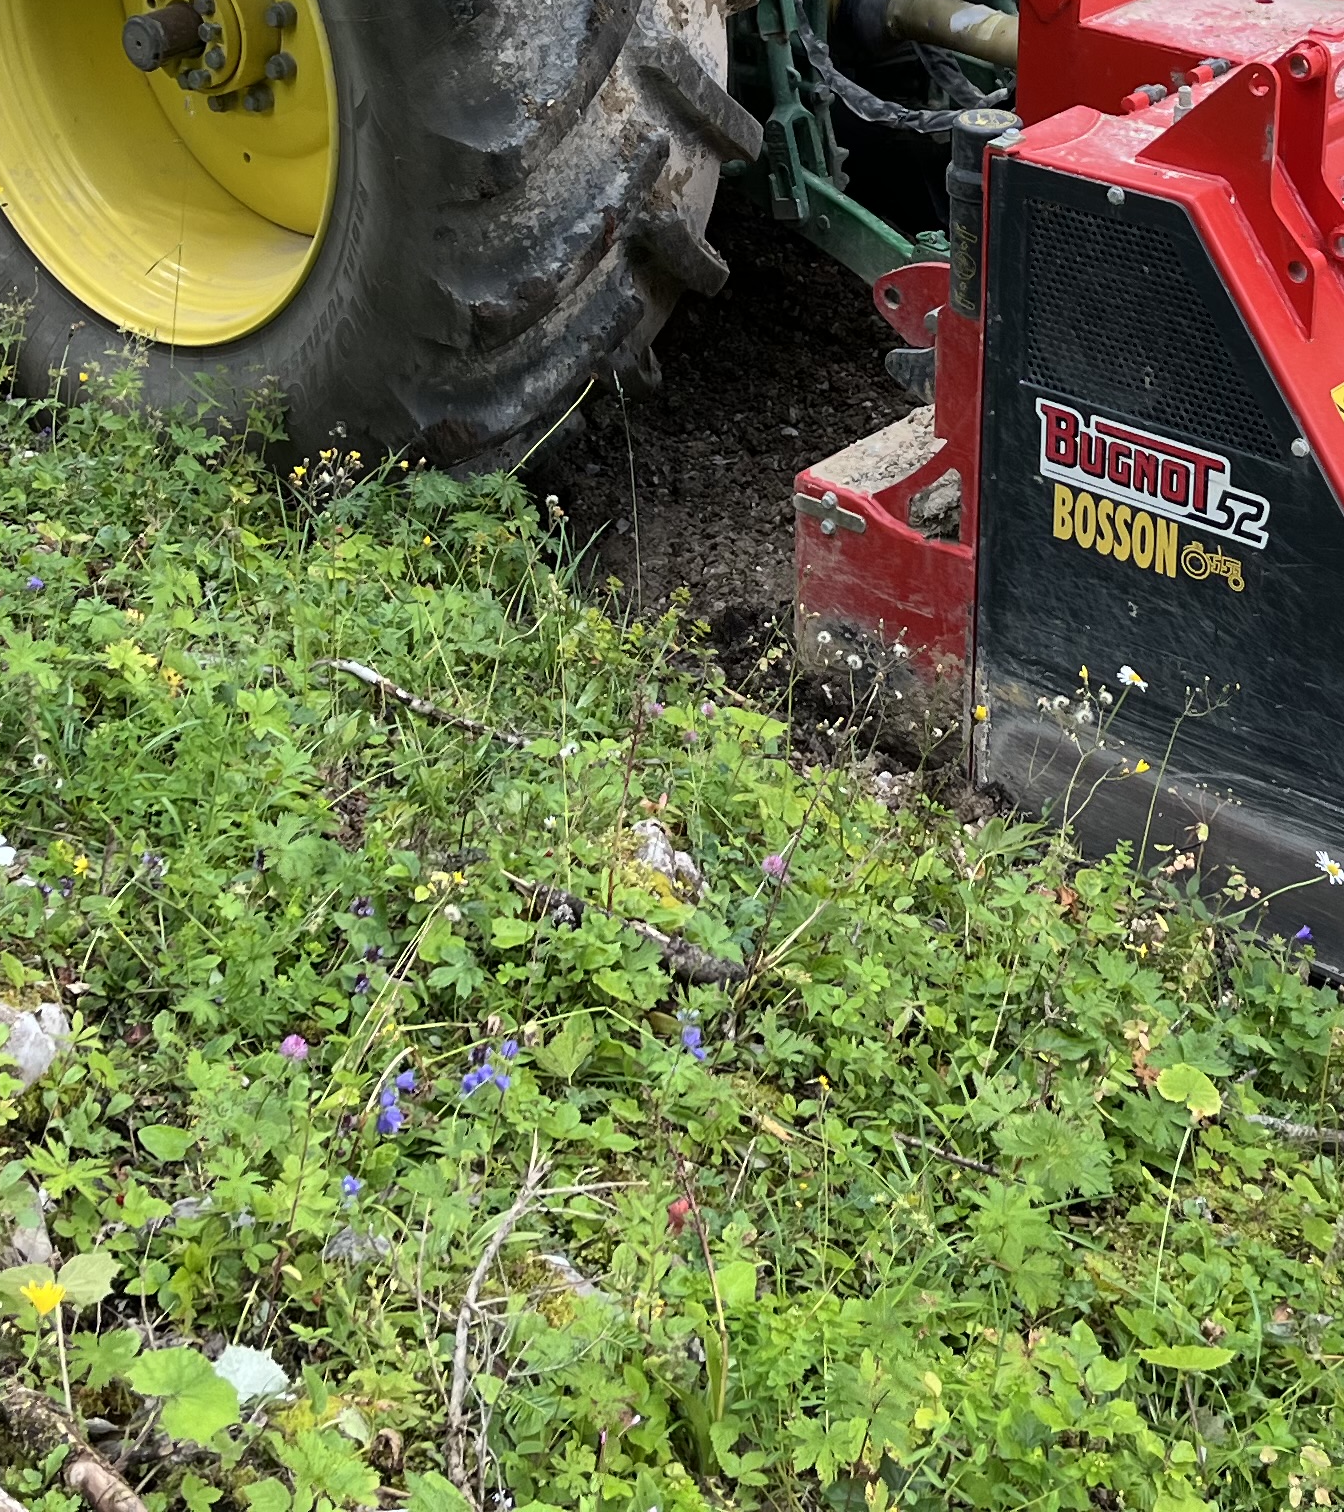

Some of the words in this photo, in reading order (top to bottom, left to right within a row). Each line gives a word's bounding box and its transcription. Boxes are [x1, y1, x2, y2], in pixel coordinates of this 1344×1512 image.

[1040, 402, 1226, 514] BUGNOT
[1184, 489, 1265, 544] 52
[1052, 482, 1178, 579] BOSSON
